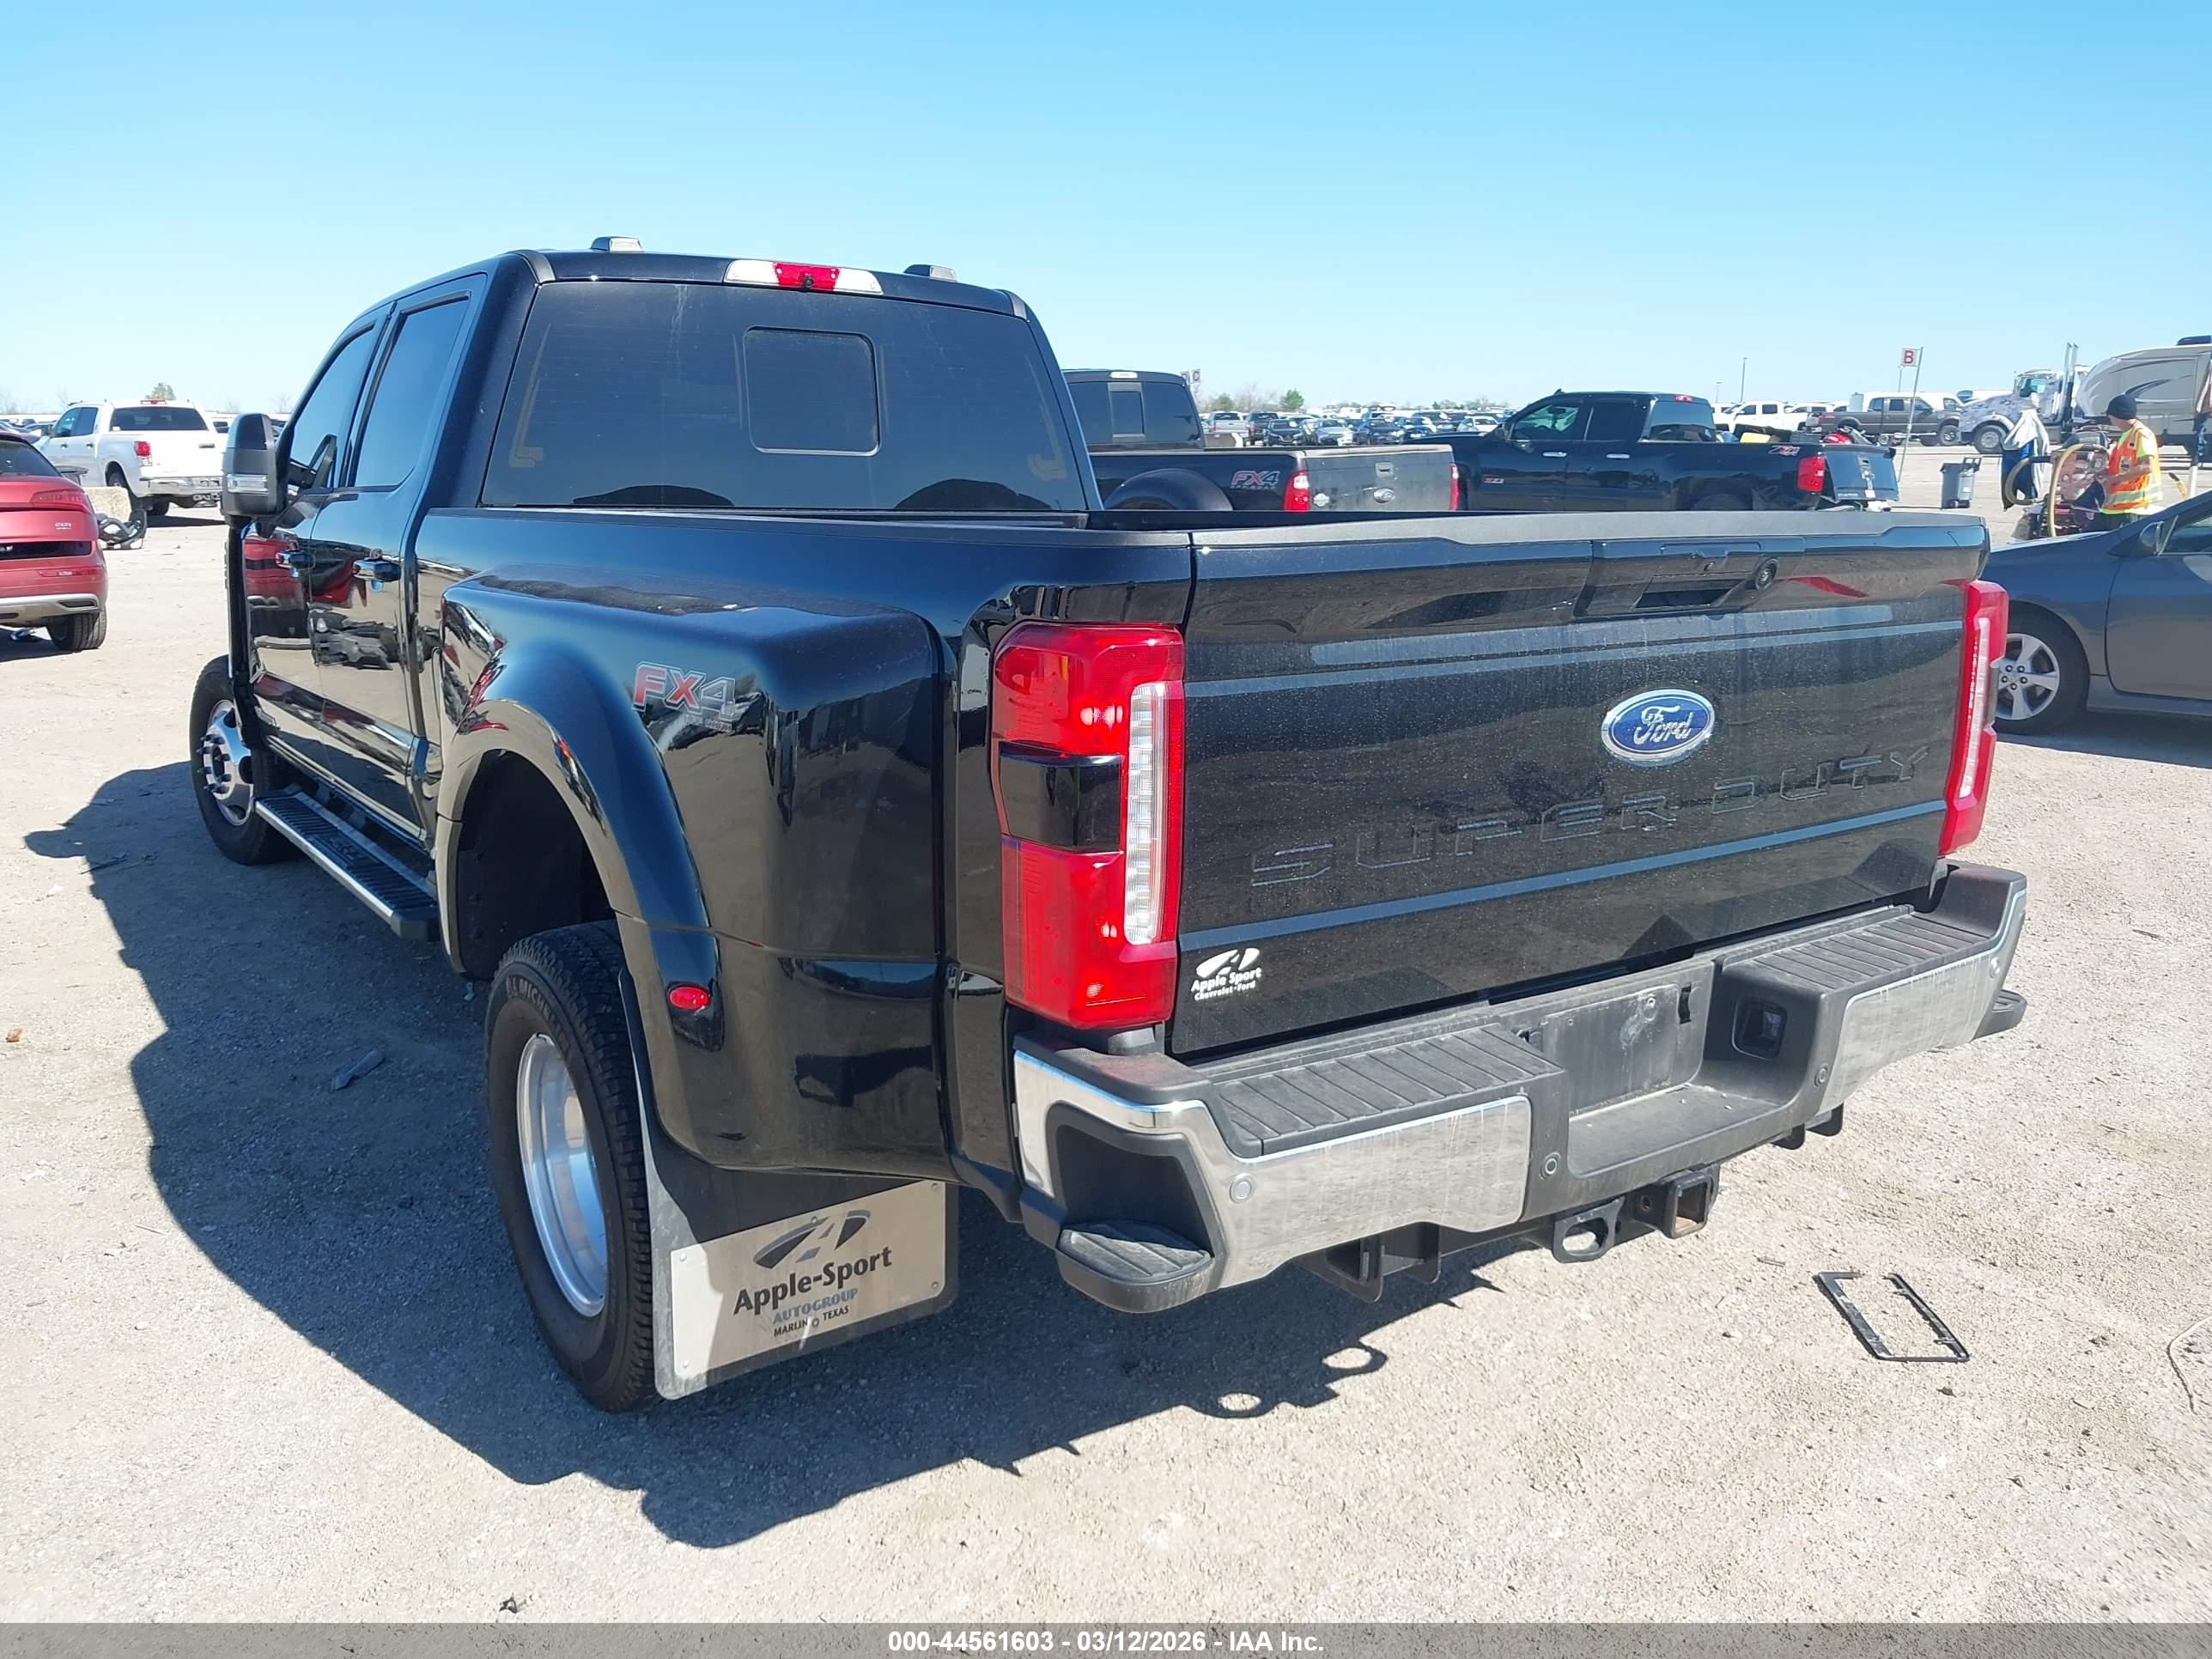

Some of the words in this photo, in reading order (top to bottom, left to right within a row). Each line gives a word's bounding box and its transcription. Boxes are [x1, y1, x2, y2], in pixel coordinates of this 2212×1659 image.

[1904, 349, 1914, 364] B
[1231, 470, 1280, 486] FX4
[632, 661, 736, 721] FX4
[1632, 704, 1694, 745] Ford
[1250, 789, 1677, 887] SUPER
[1711, 744, 1930, 815] DUTY
[1190, 974, 1227, 993] Apple
[1229, 967, 1262, 985] Sport
[732, 1246, 893, 1316] Apple-Sport
[773, 1288, 859, 1324] AUTOGROUP
[774, 1318, 808, 1337] MARLIN
[822, 1305, 849, 1322] TEXAS
